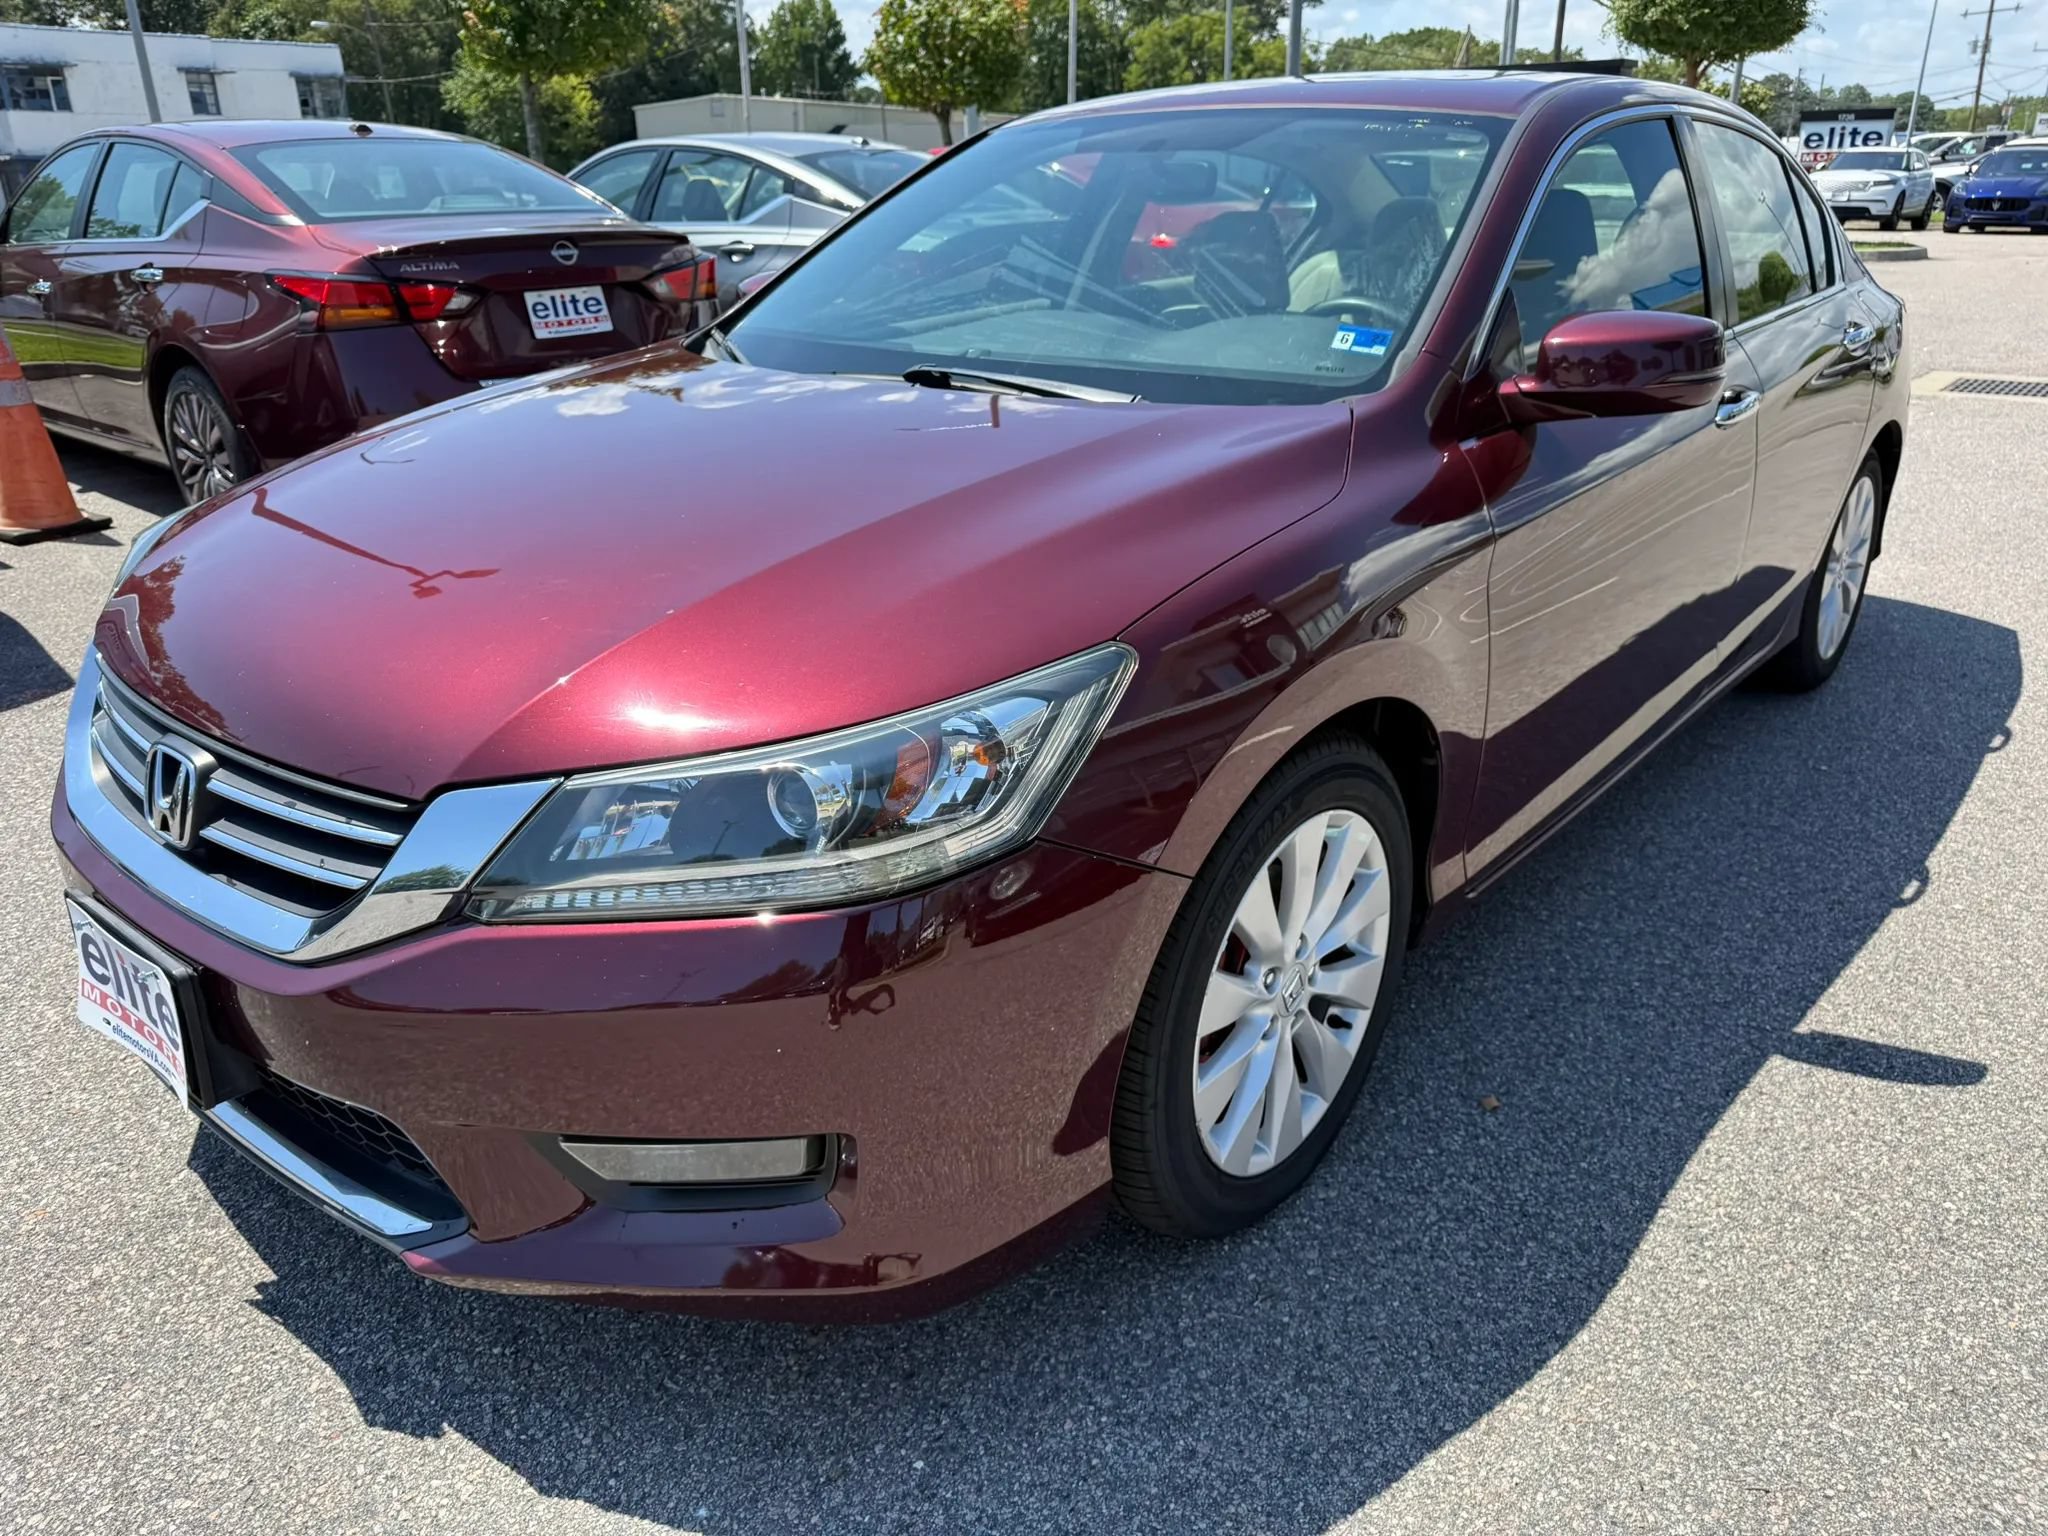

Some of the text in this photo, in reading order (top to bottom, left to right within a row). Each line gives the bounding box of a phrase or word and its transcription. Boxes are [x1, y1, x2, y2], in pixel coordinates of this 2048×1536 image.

[1804, 125, 1883, 149] elite
[400, 261, 460, 273] ALTIMA
[531, 293, 604, 320] elite
[1340, 333, 1350, 345] 6
[81, 932, 180, 1052] elite
[82, 978, 185, 1081] MOTORS
